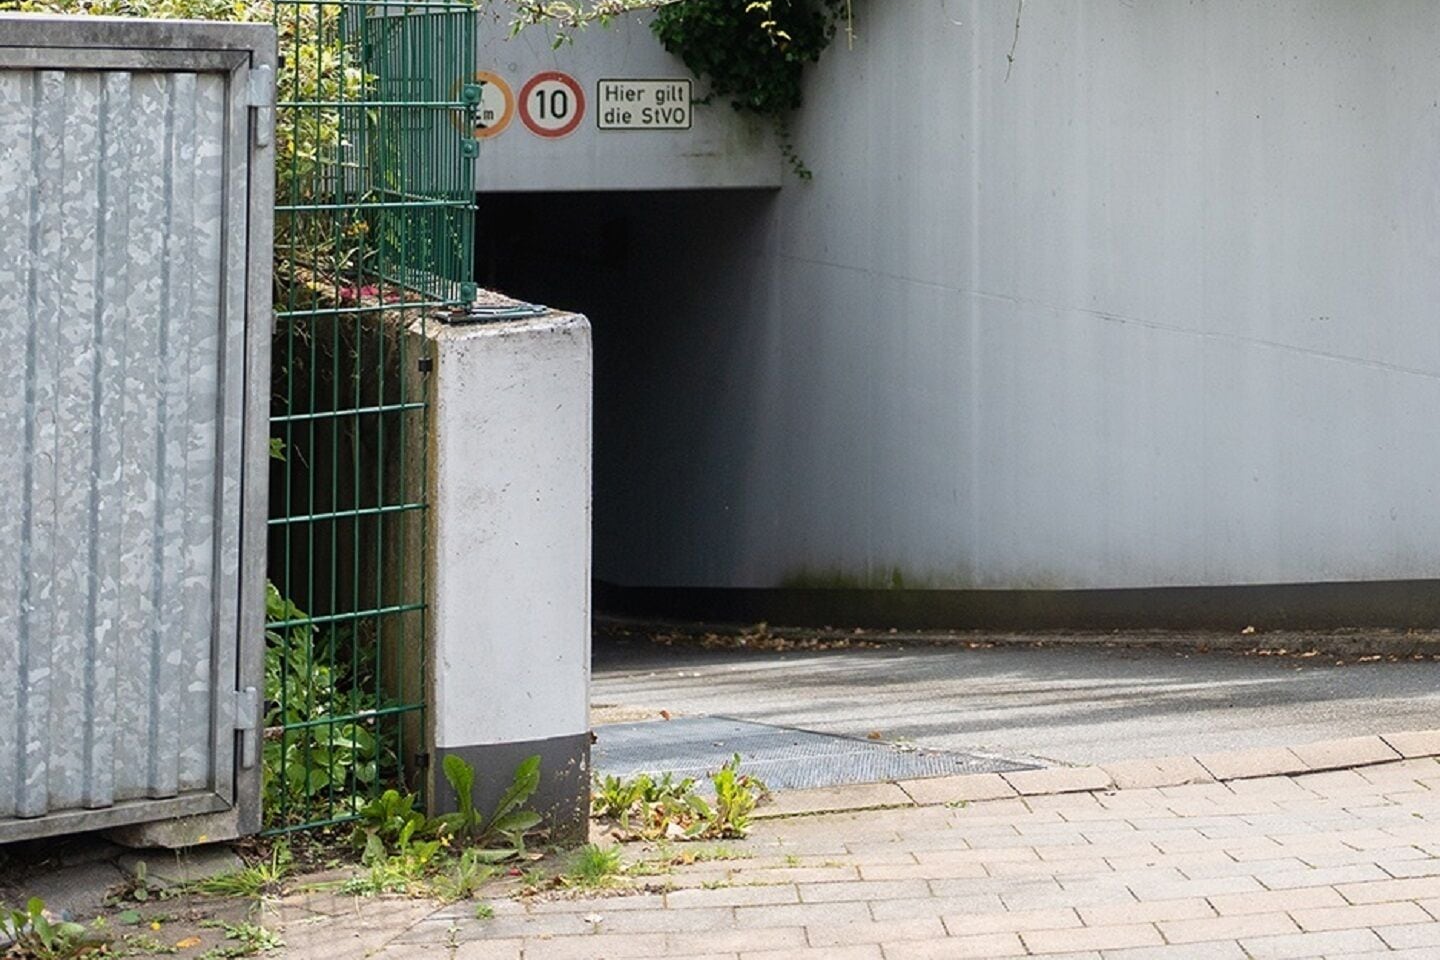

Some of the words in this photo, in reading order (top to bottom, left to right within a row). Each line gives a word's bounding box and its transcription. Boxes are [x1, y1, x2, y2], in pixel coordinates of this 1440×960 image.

[536, 89, 568, 120] 10
[605, 85, 645, 102] Hier
[655, 85, 684, 107] gilt
[604, 107, 632, 124] die
[641, 107, 686, 124] StVO
